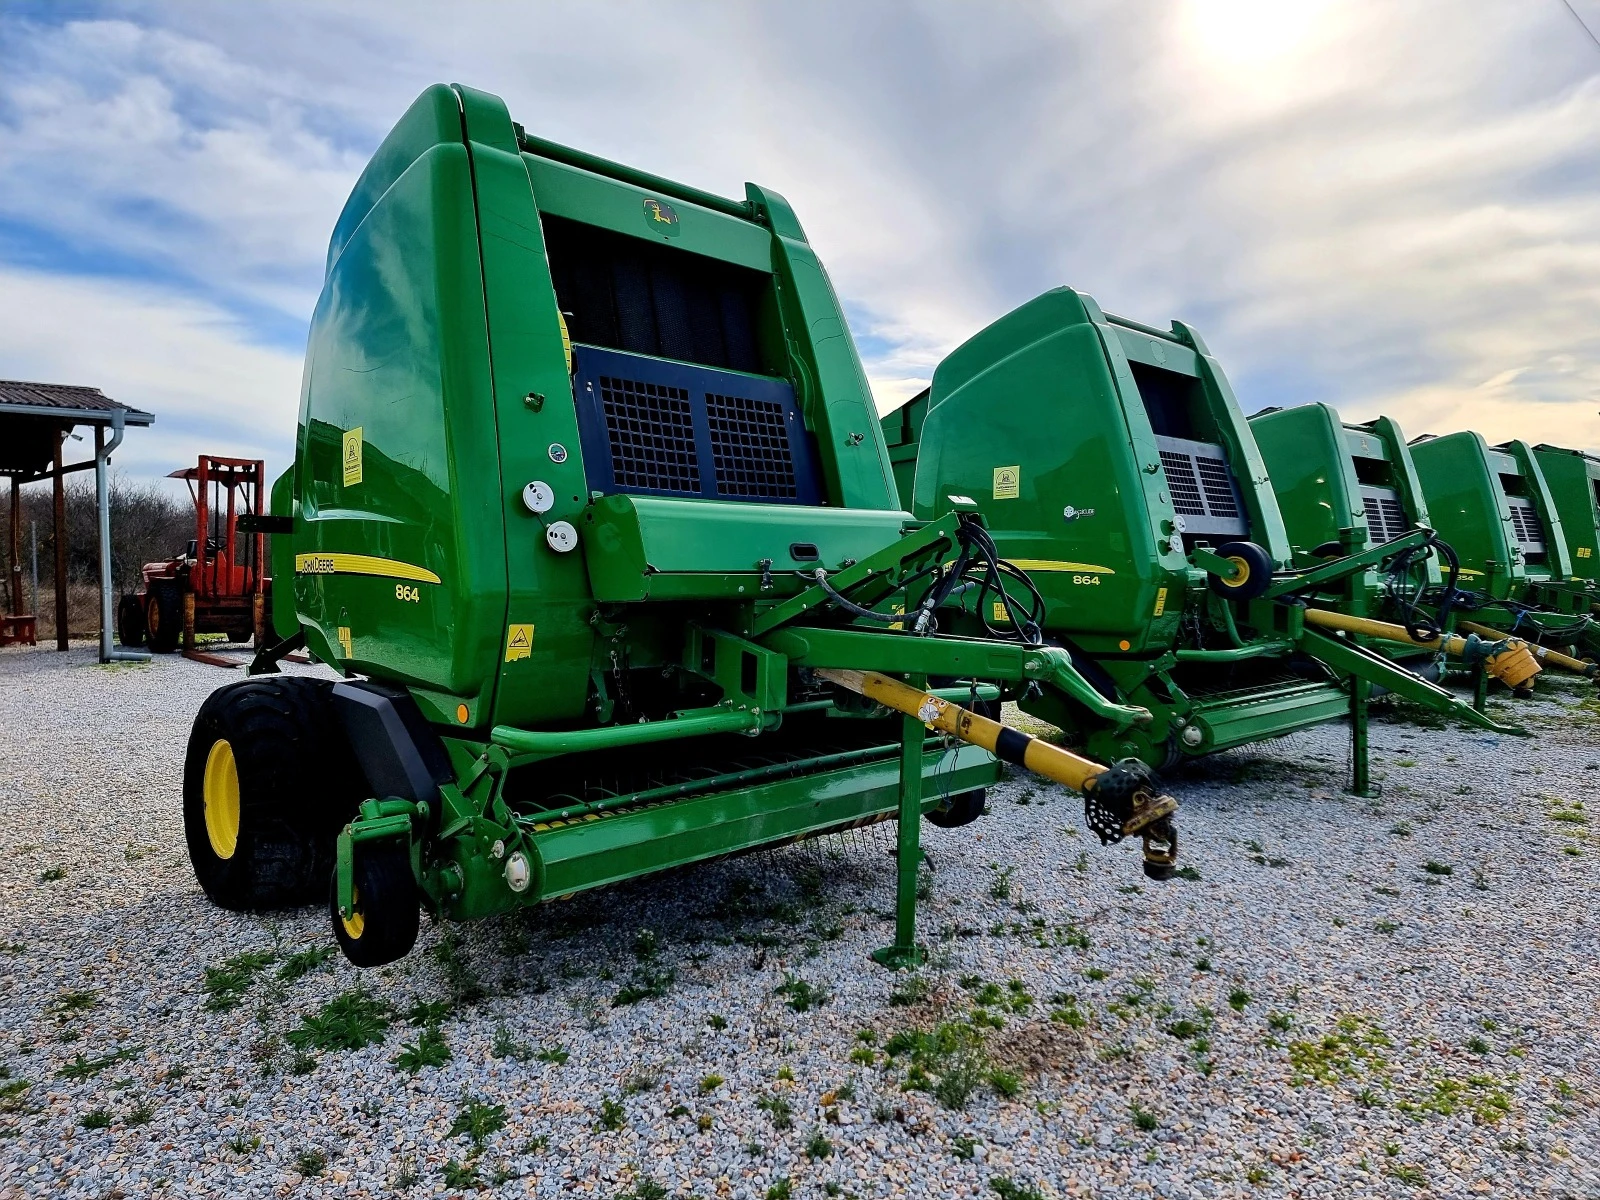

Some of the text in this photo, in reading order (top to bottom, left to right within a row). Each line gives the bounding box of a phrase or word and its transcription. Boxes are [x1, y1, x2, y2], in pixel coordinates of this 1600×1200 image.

[314, 557, 334, 573] DEERE
[1073, 575, 1100, 585] 864
[395, 584, 419, 603] 864
